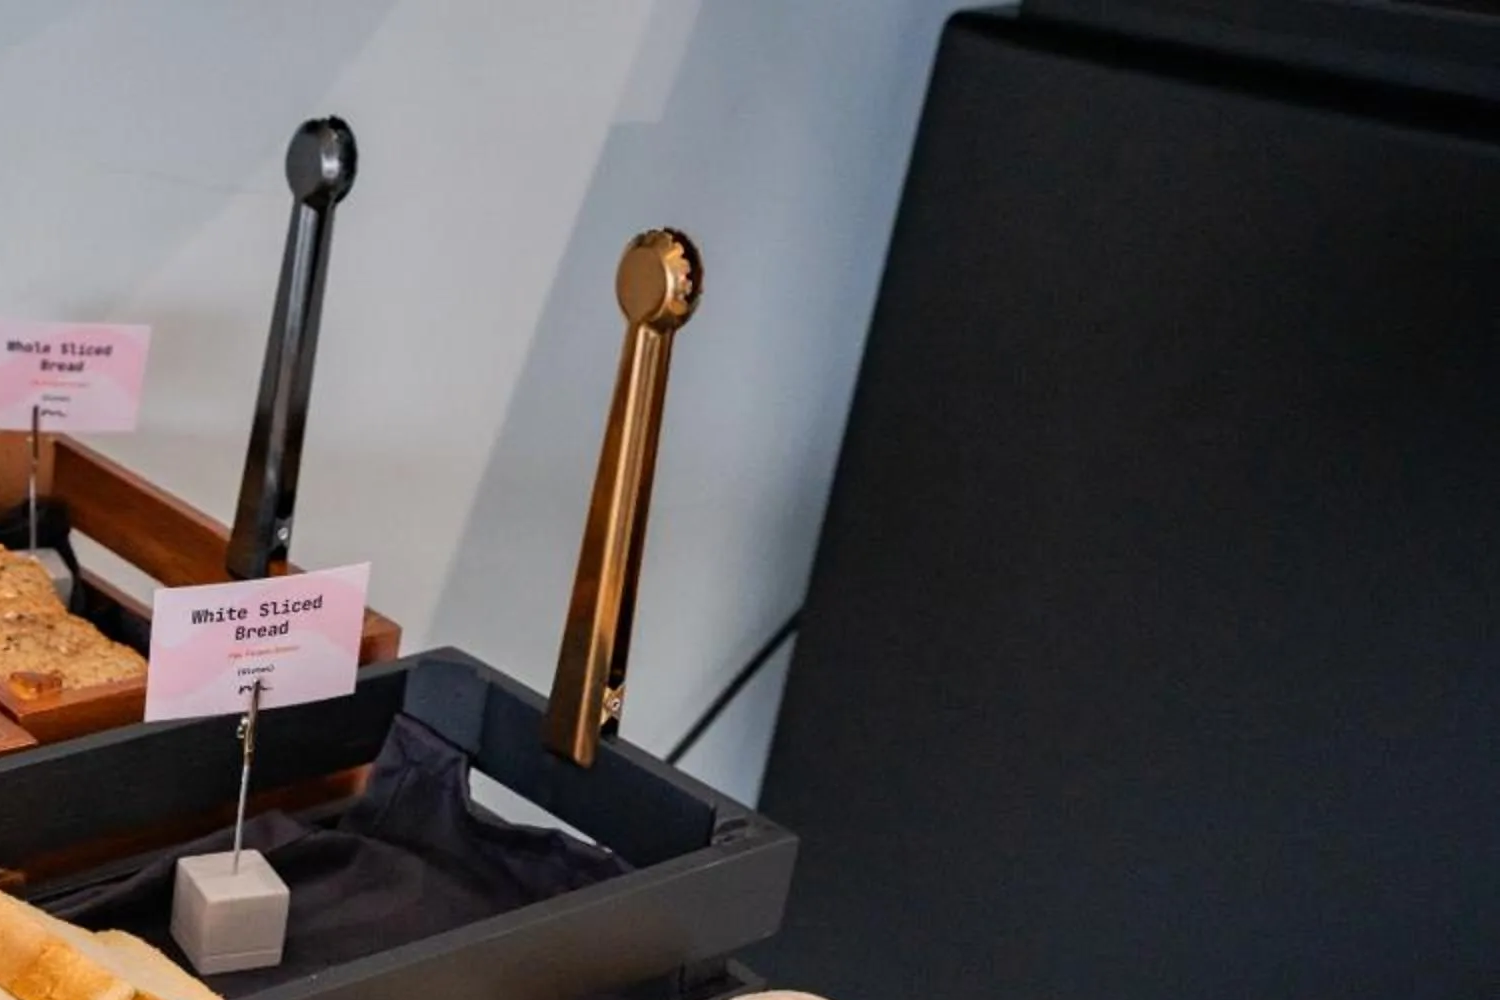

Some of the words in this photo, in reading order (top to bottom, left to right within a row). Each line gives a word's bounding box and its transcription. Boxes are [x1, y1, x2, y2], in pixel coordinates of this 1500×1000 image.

[6, 340, 52, 354] Whole
[60, 342, 113, 357] Sliced
[40, 359, 85, 372] Bread
[191, 606, 248, 625] White
[259, 595, 323, 618] Sliced
[235, 621, 289, 641] Bread
